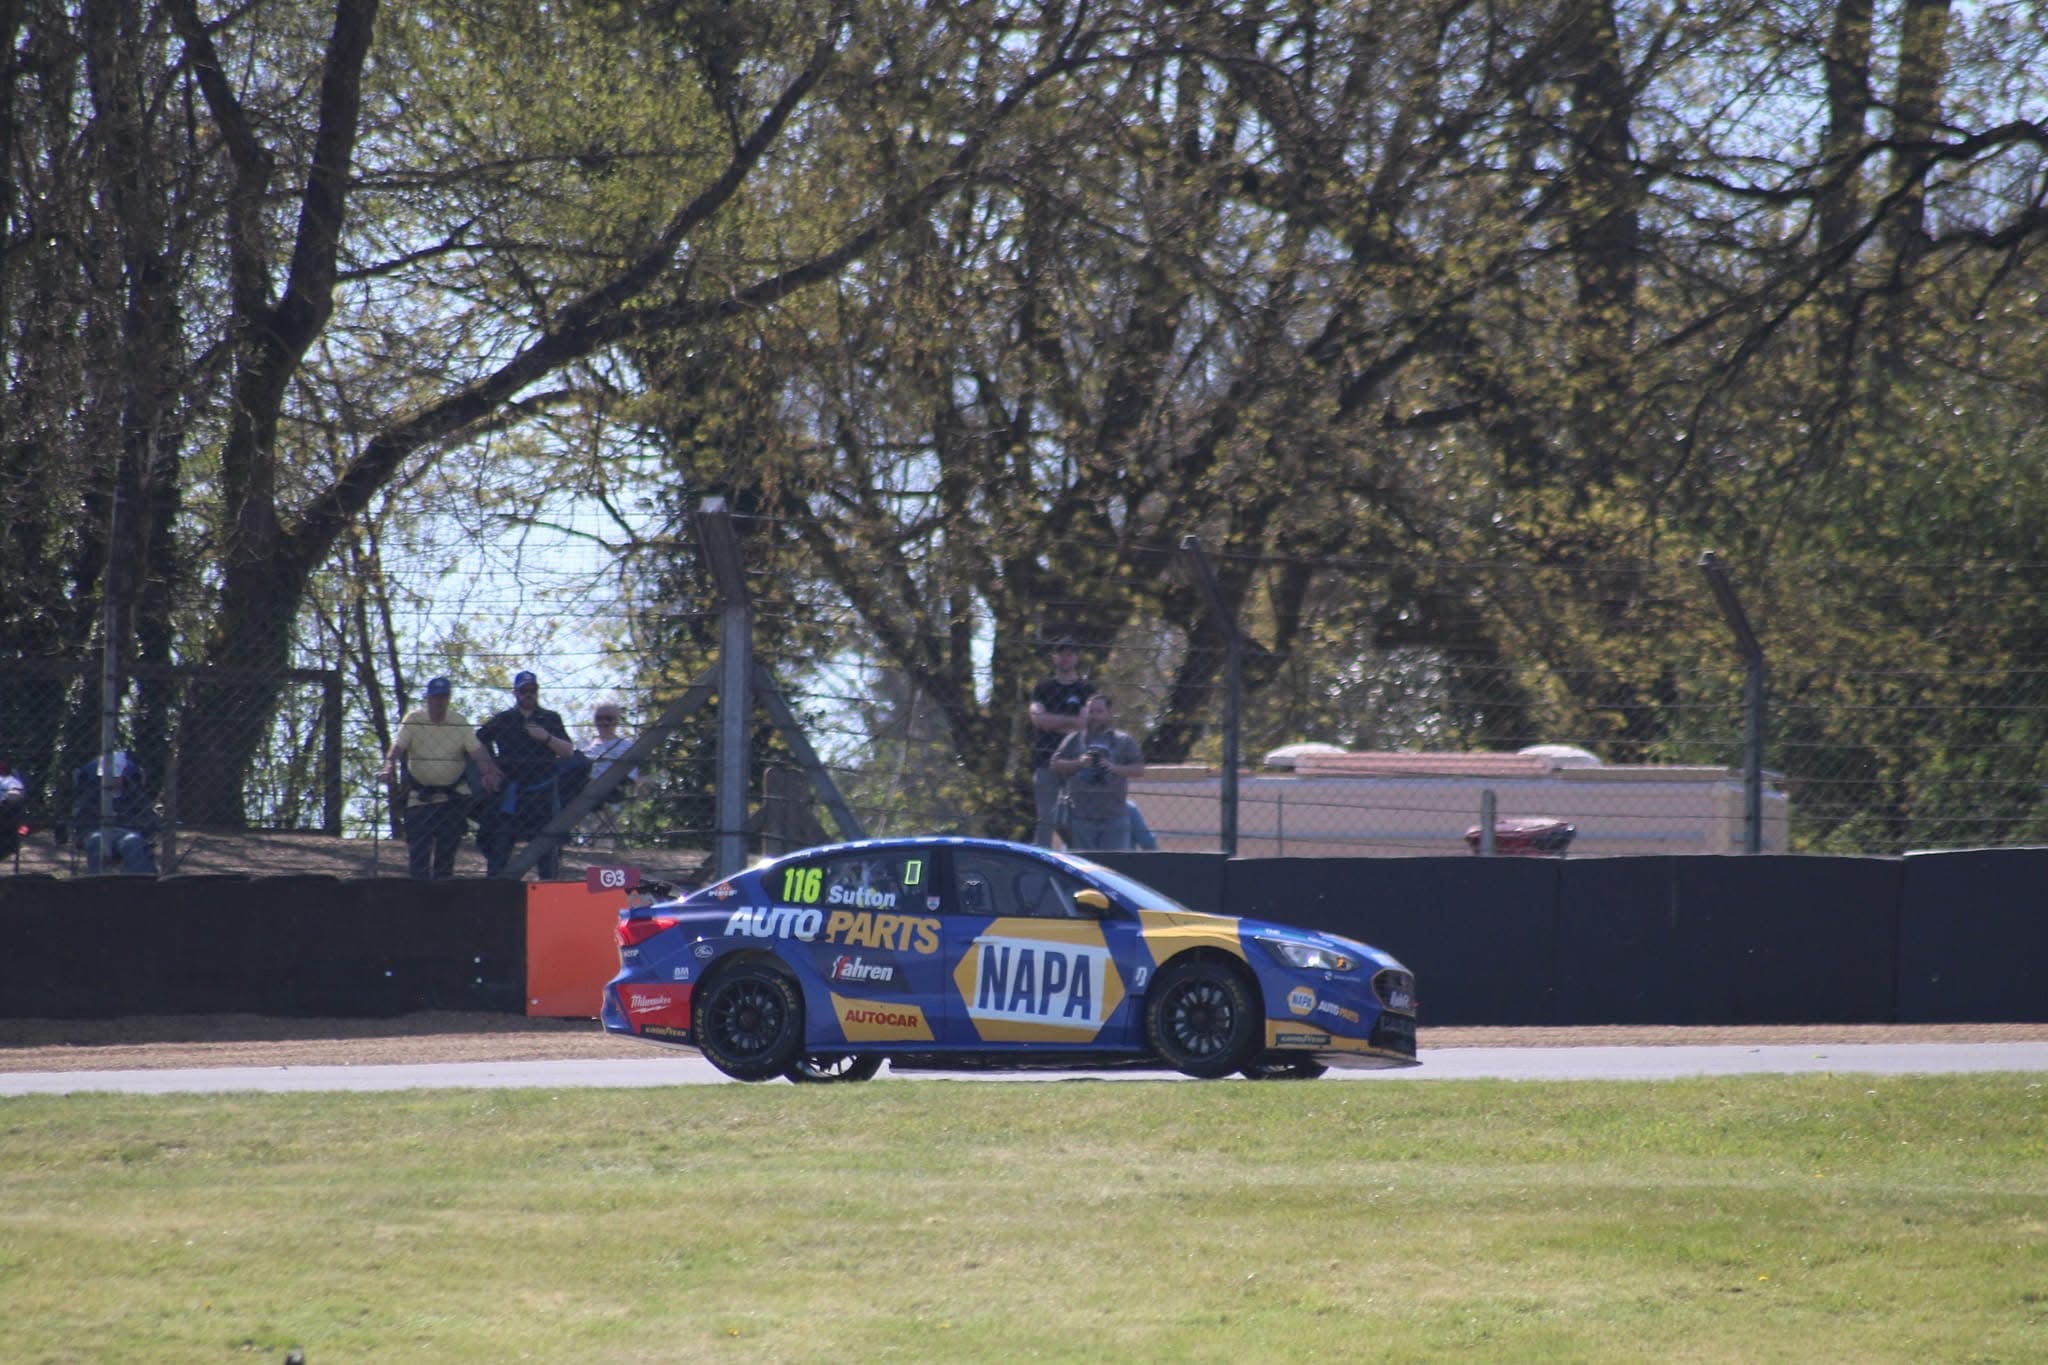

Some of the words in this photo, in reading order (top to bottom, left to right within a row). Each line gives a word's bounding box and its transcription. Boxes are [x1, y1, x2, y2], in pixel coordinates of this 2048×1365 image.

[600, 869, 626, 888] G3
[783, 868, 823, 904] 116
[828, 885, 896, 908] Sutton
[724, 906, 823, 941] AUTO
[825, 910, 942, 955] PARTS
[978, 945, 1092, 1020] NAPA
[845, 1009, 919, 1028] AUTOCAR
